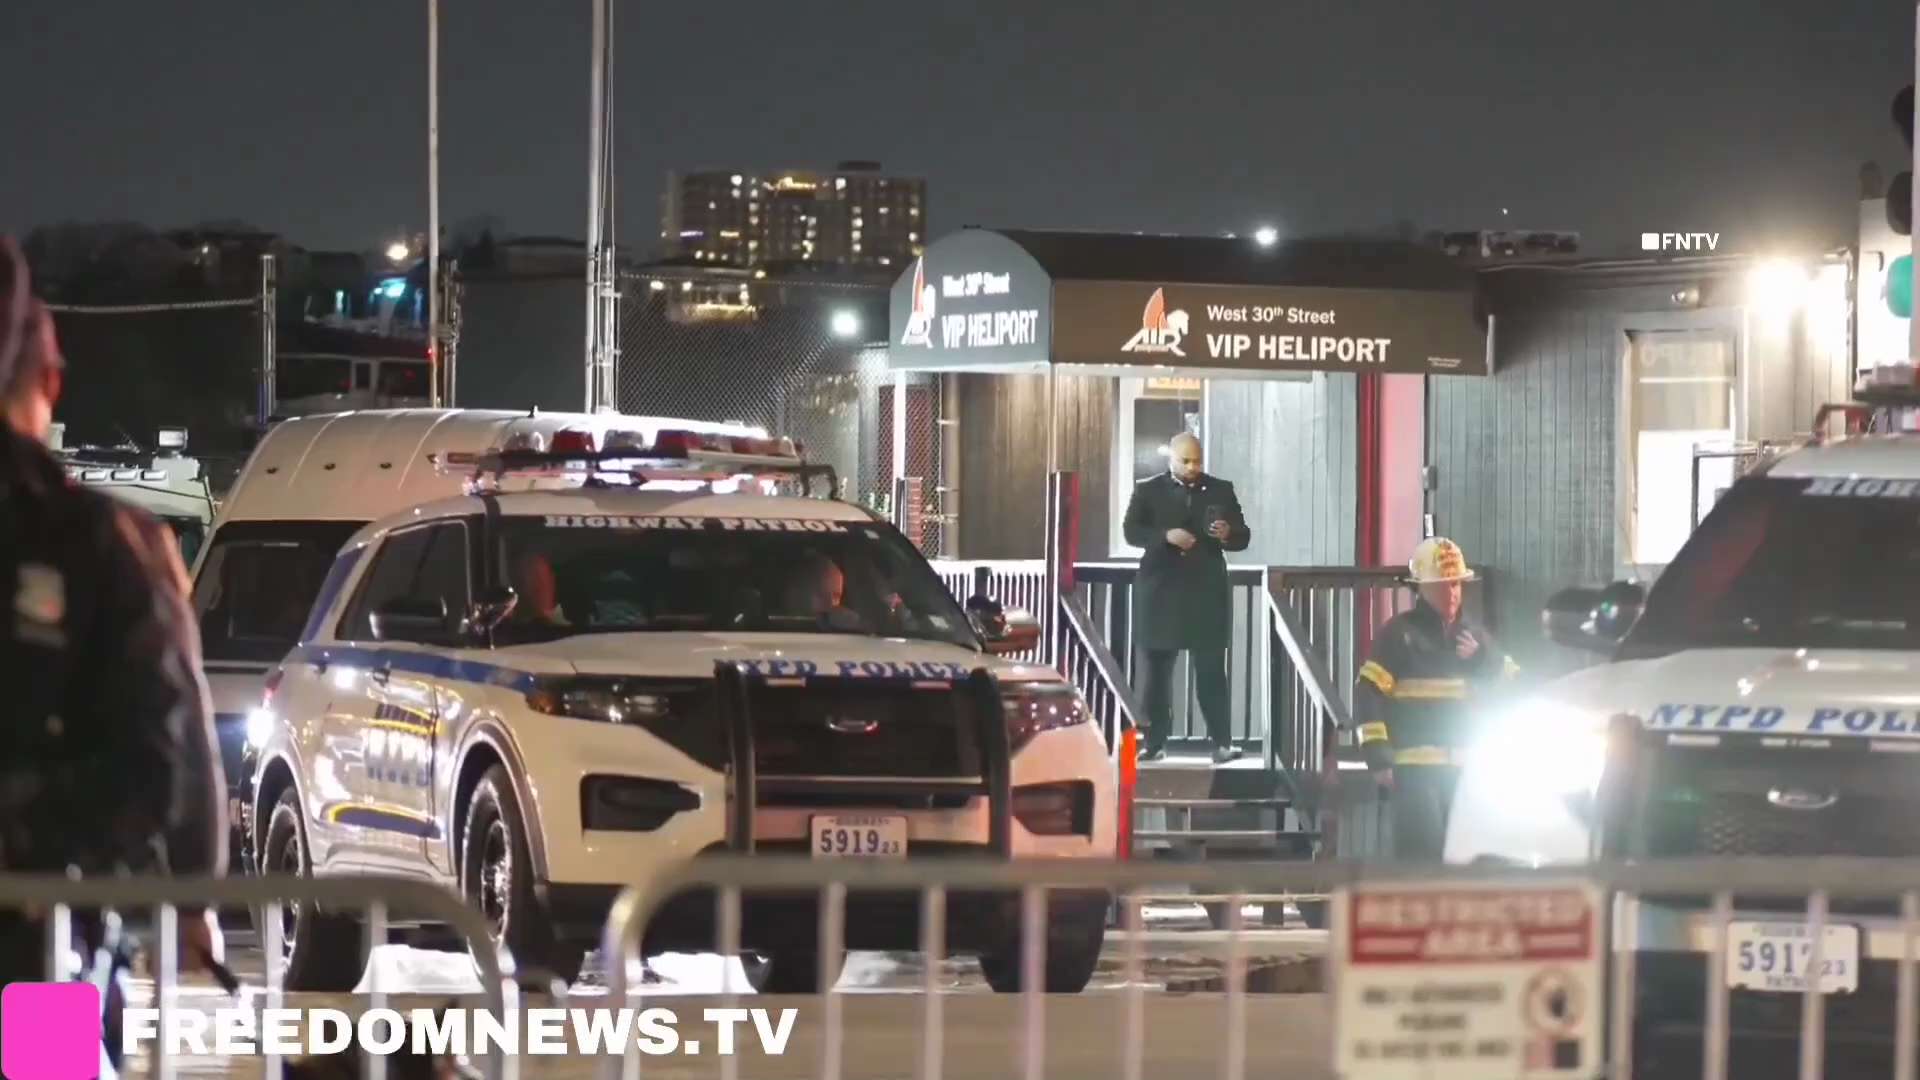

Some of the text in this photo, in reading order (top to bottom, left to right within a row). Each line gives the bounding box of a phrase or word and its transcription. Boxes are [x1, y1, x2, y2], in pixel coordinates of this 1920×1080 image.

[1206, 304, 1336, 325] West 30th Street
[941, 309, 1039, 349] VIP HELIPORT
[1119, 328, 1187, 357] AIR
[1205, 333, 1392, 363] VIP HELIPORT
[543, 514, 849, 533] HIGHWAY PATROL
[835, 660, 971, 681] POLICE
[1648, 703, 1786, 729] NYPD
[820, 828, 880, 854] 5919
[1422, 927, 1522, 957] AREA
